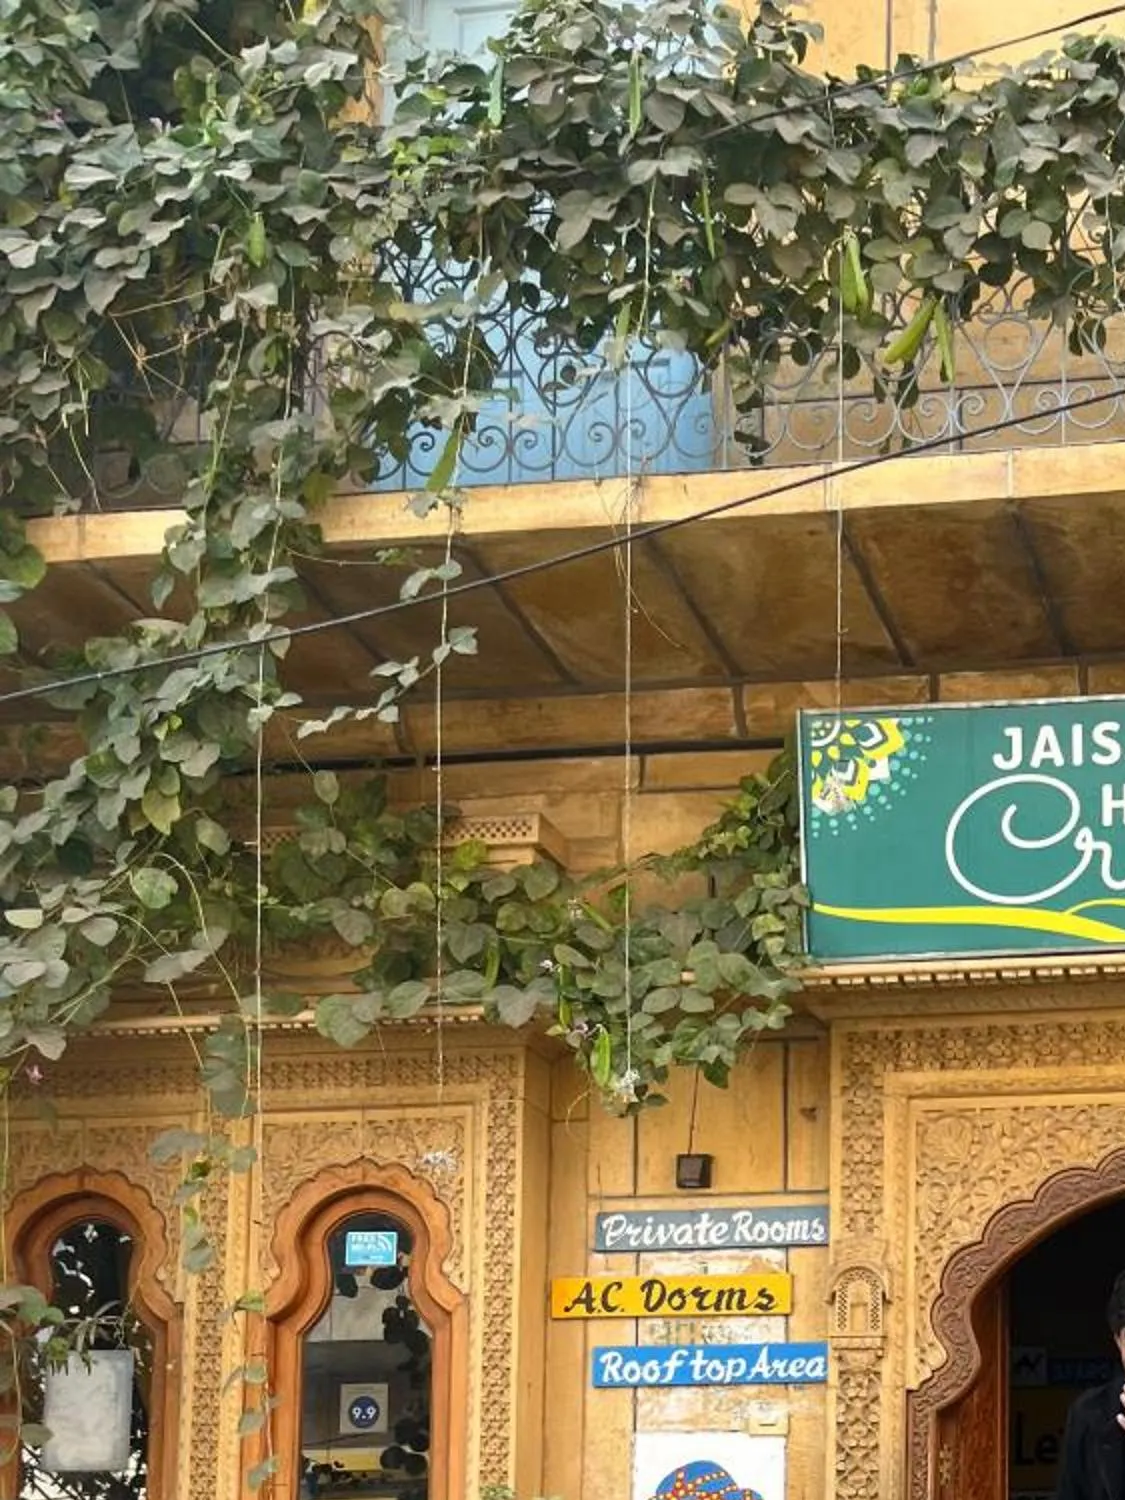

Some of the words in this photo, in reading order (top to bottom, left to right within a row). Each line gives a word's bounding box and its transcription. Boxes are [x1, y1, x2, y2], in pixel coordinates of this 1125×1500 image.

[600, 1211, 730, 1248] Private
[731, 1210, 827, 1243] Rooms
[639, 1278, 778, 1312] Dorms
[745, 1345, 827, 1381] Area
[351, 1406, 378, 1420] 9.9
